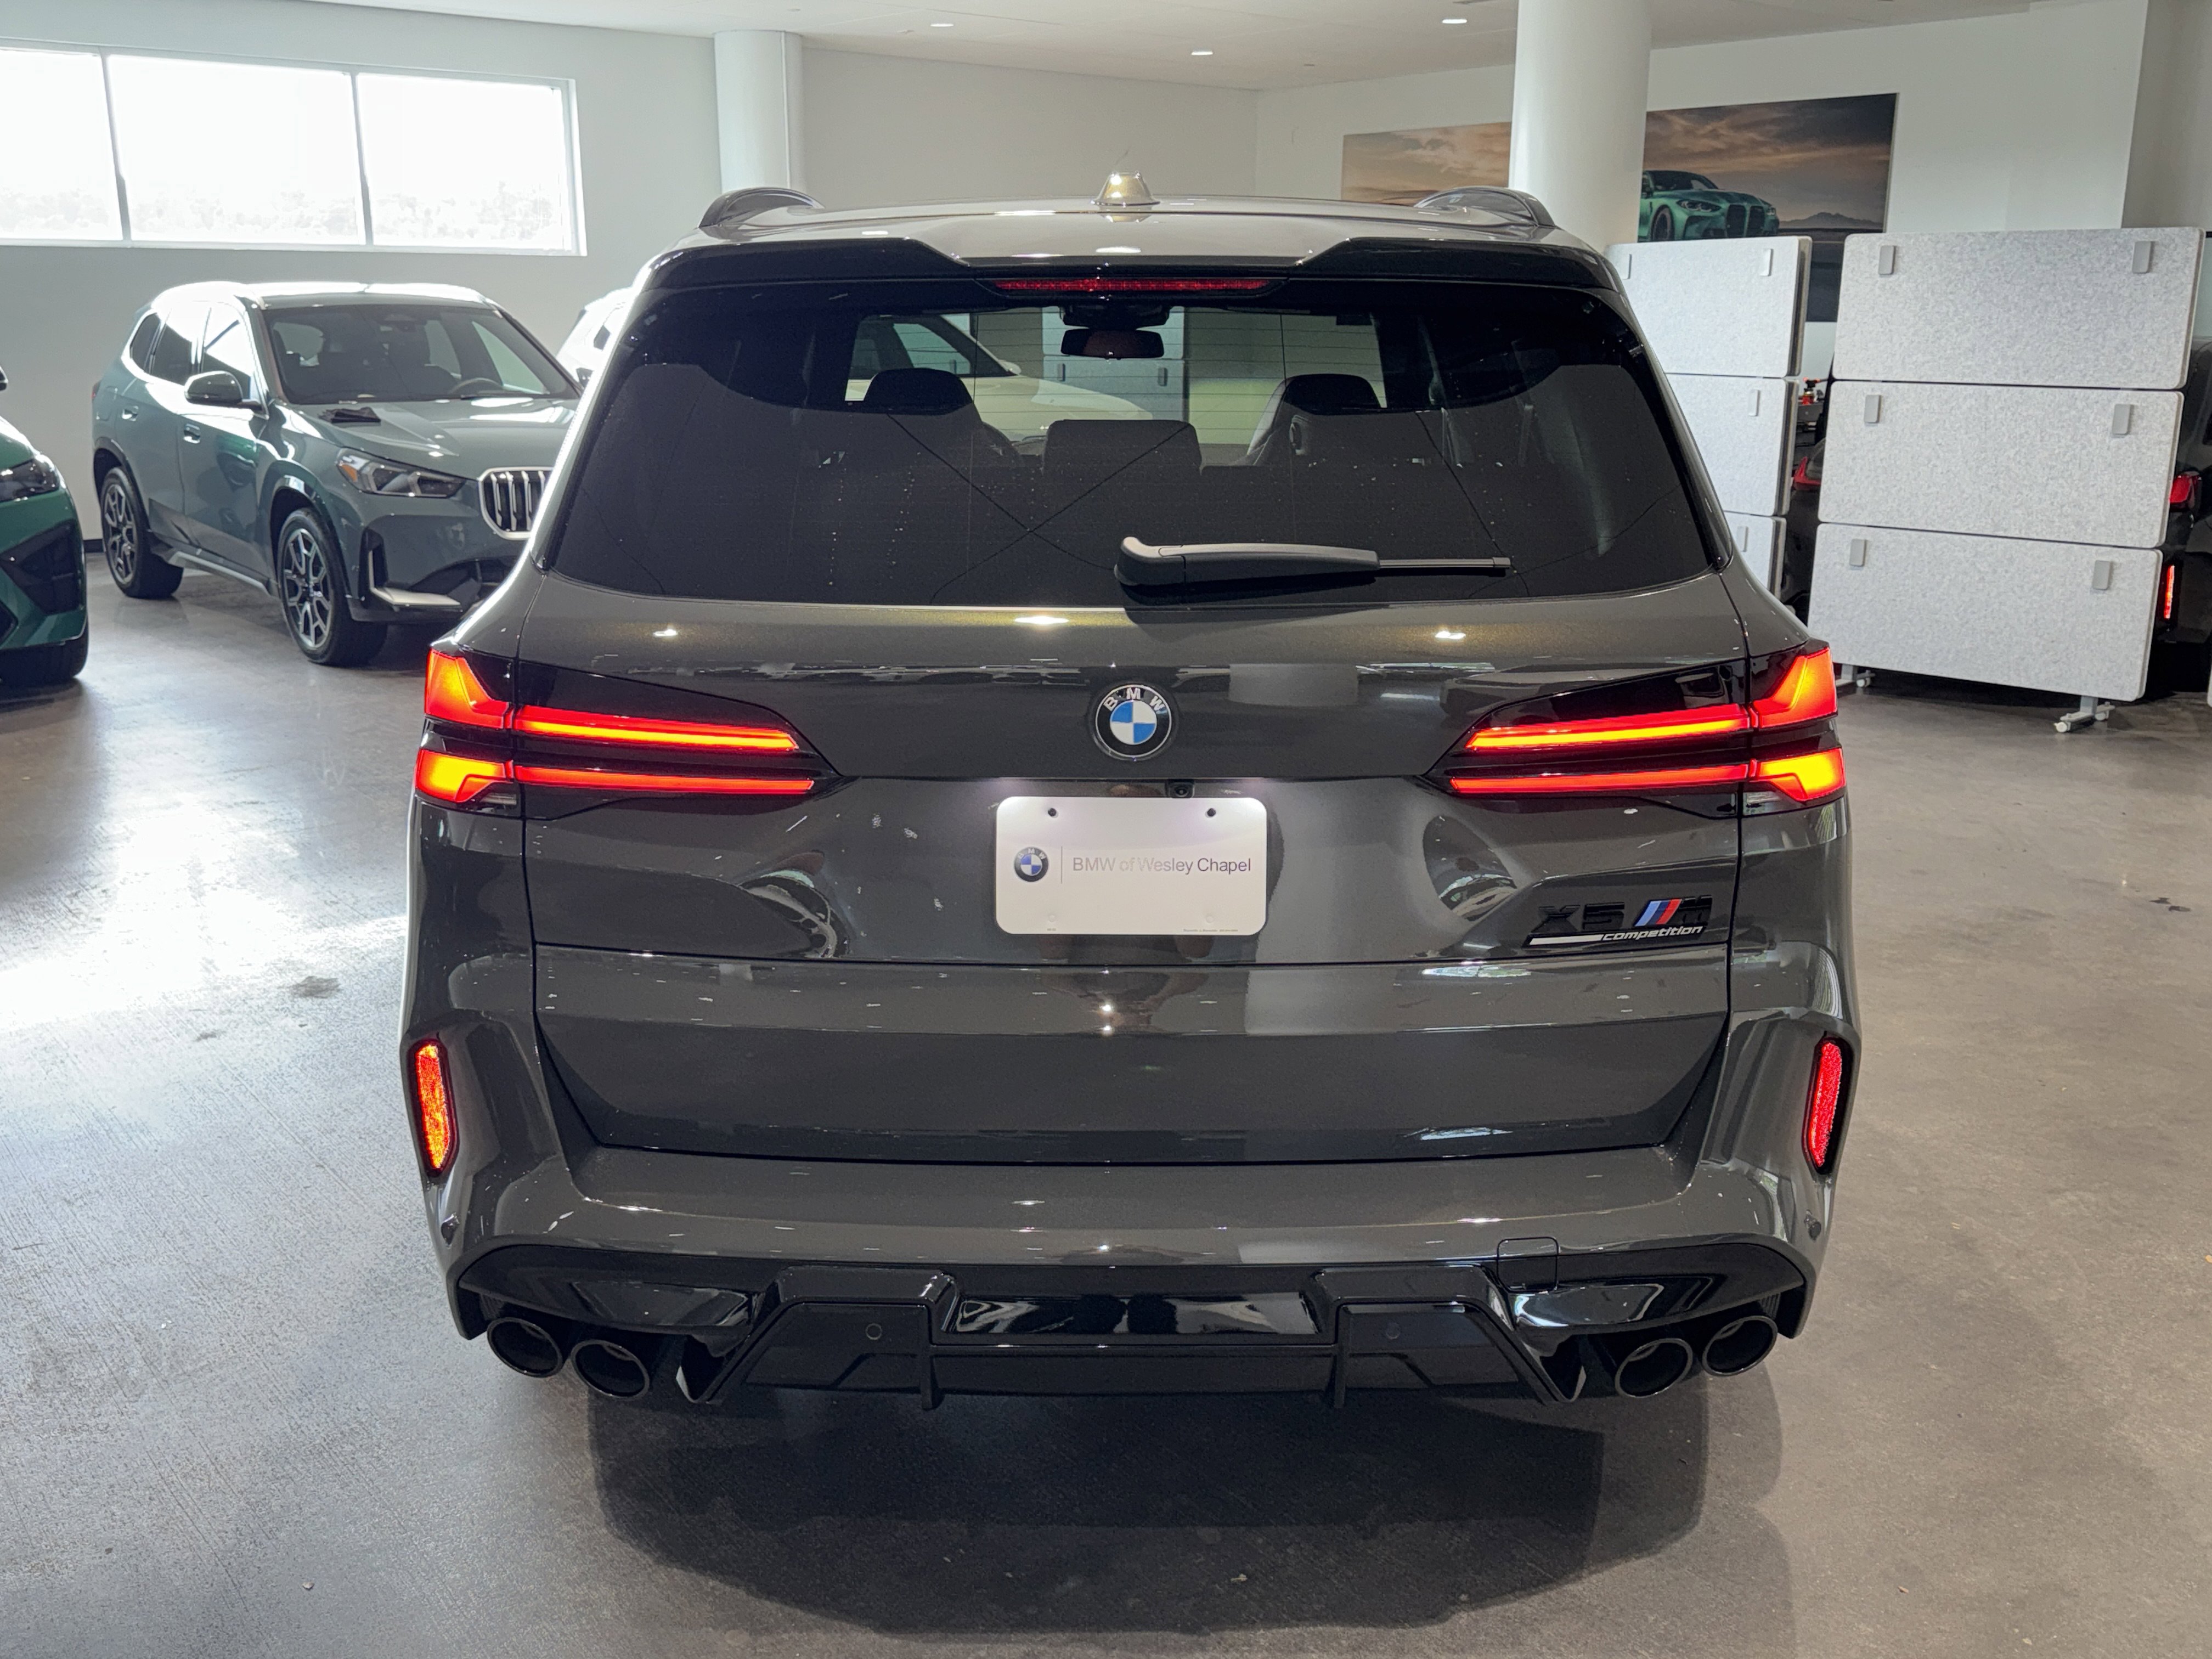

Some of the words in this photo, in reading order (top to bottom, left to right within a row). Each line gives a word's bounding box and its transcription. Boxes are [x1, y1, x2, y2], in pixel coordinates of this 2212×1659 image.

[1104, 687, 1165, 712] BMW
[1017, 848, 1046, 860] BMW
[1073, 857, 1115, 871] BMW
[1120, 857, 1135, 871] of
[1138, 857, 1193, 874] Wesley
[1197, 857, 1251, 874] Chapel
[1531, 902, 1626, 933] X5
[1602, 926, 1703, 941] competition
